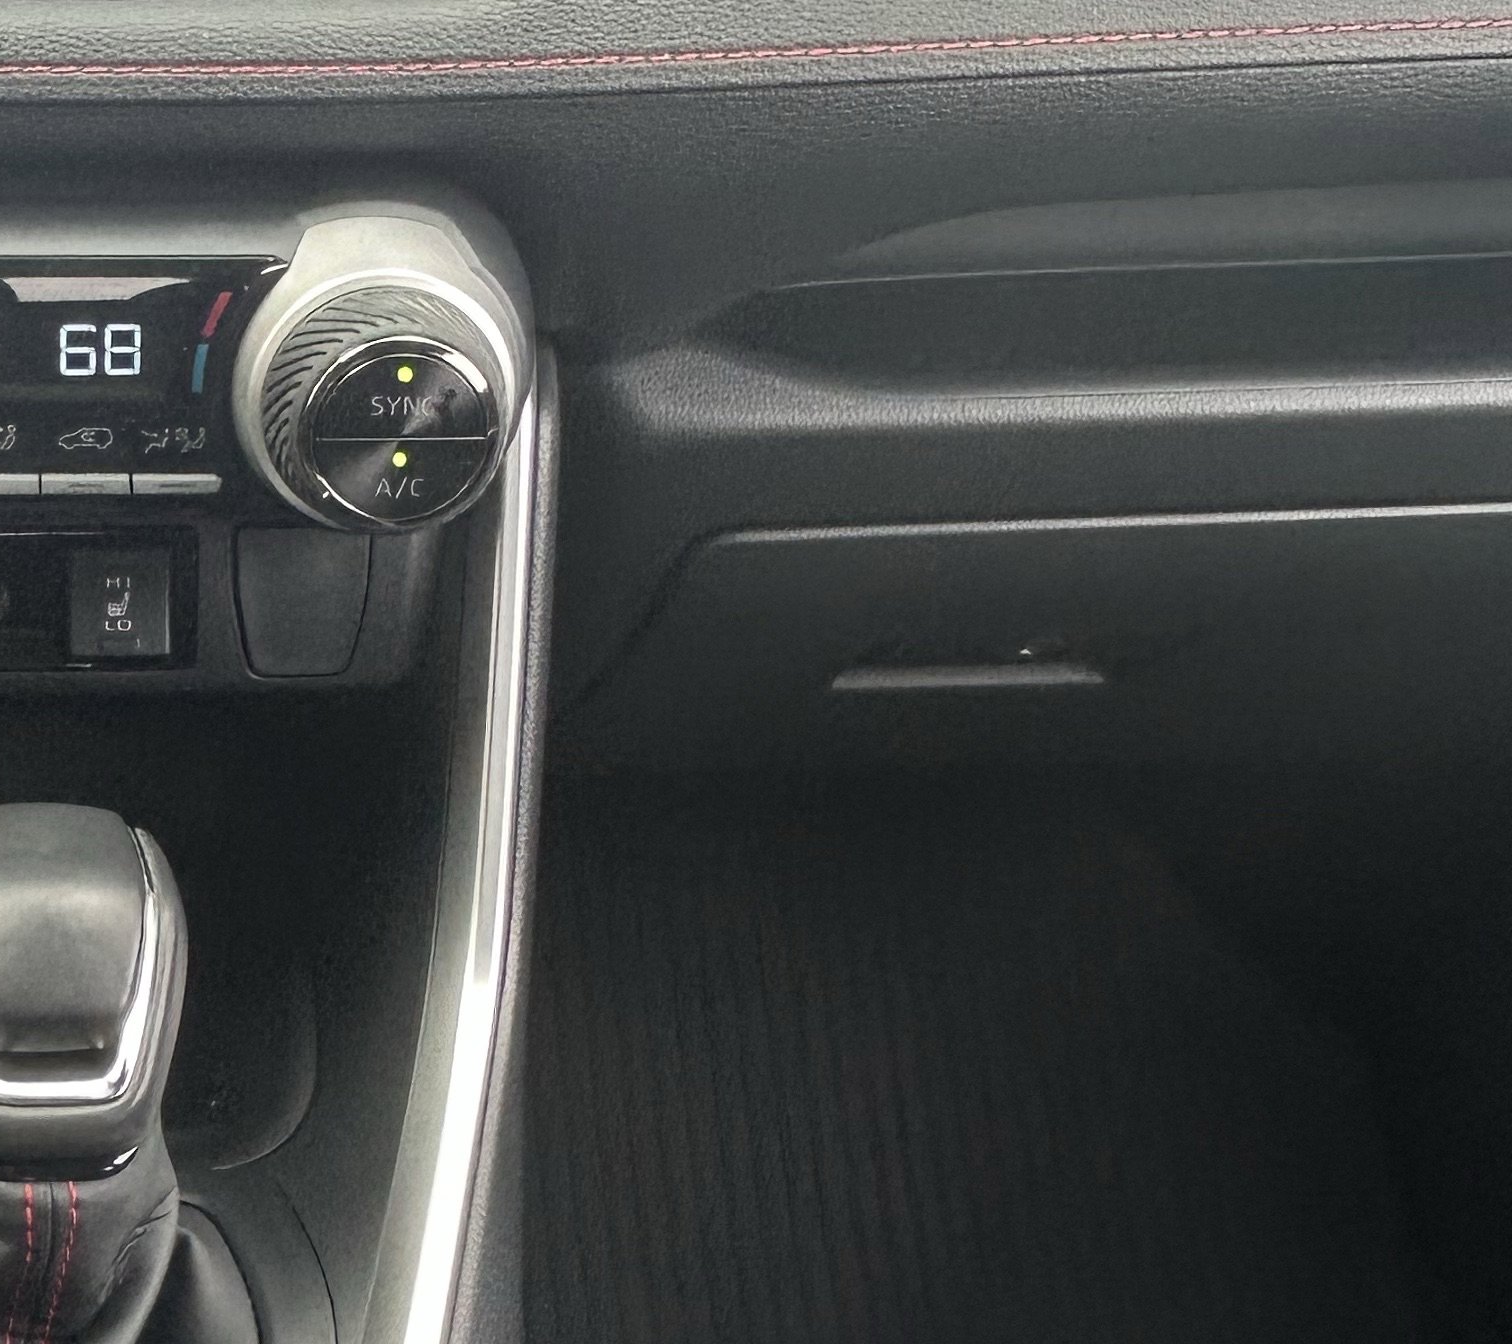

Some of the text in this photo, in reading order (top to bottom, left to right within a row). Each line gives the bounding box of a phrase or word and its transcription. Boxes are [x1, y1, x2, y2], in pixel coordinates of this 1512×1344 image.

[58, 322, 142, 377] 68
[369, 395, 434, 417] SYNC
[374, 476, 425, 499] A/C
[105, 576, 131, 590] HI
[104, 620, 132, 632] LO
